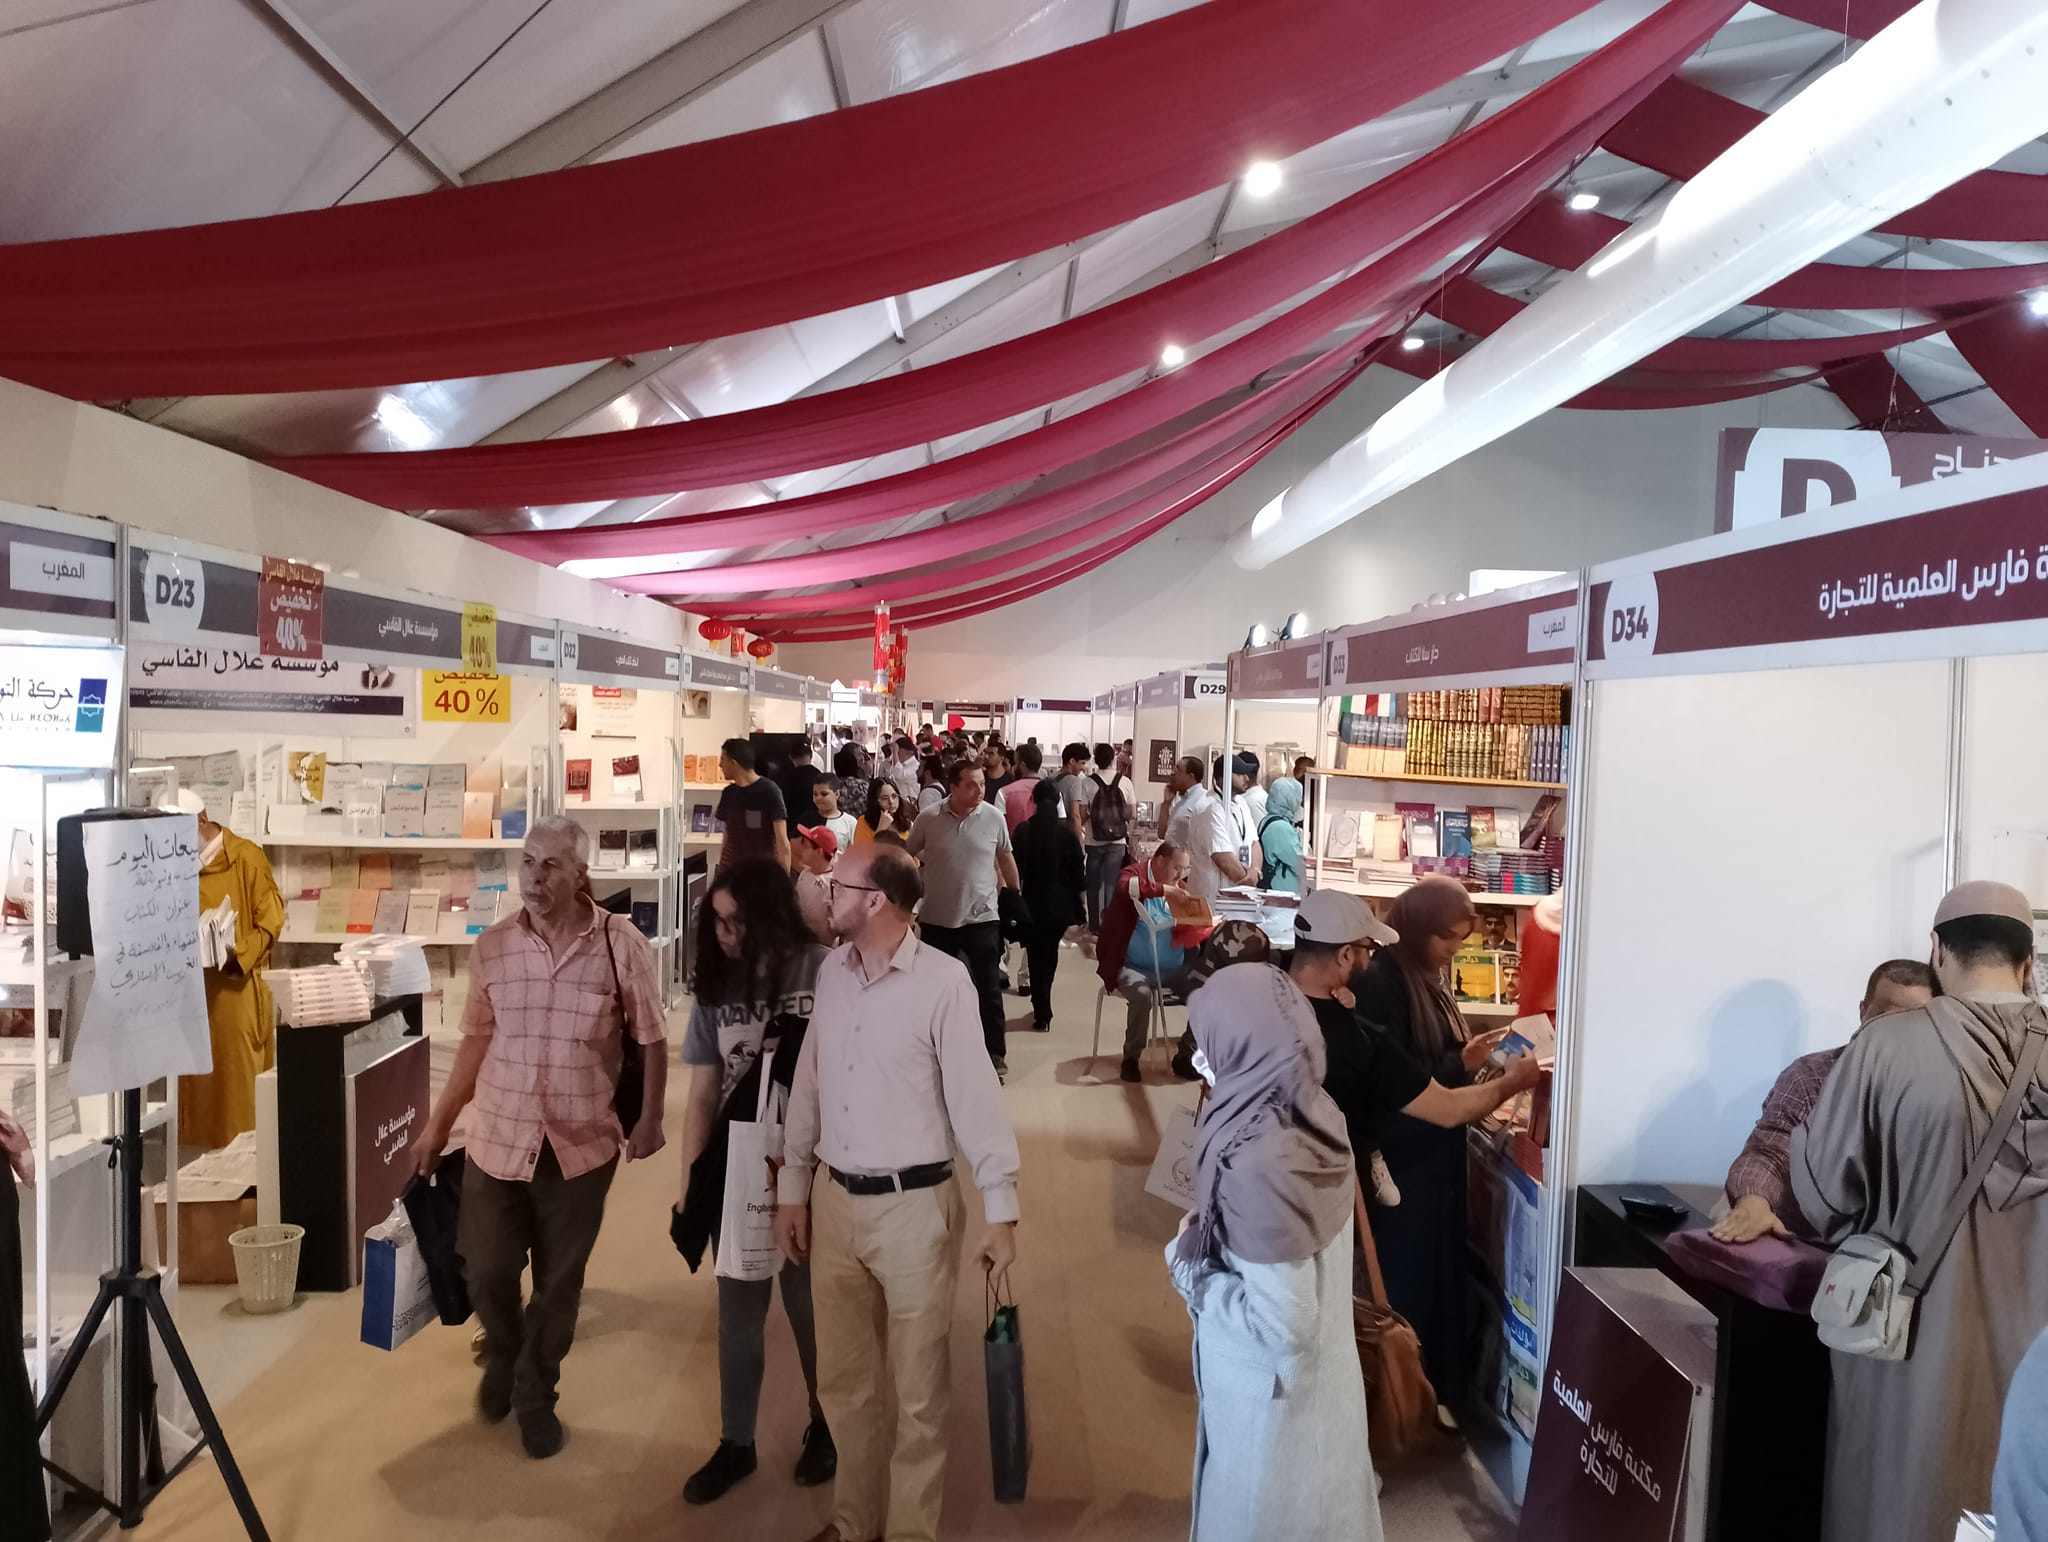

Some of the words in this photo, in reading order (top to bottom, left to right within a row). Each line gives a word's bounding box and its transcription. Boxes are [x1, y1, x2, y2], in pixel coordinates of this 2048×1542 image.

[42, 562, 85, 579] المغرب
[1881, 559, 1957, 609] العلمية
[1962, 549, 2029, 600] فارس
[156, 574, 195, 608] D23
[270, 584, 312, 612] تخفيض
[1819, 573, 1877, 619] للتجارة
[276, 615, 307, 652] 40%
[378, 616, 402, 637] الفاسي
[414, 620, 439, 641] مؤسسة
[1543, 616, 1566, 639] المغرب
[1611, 606, 1649, 643] D34
[142, 647, 208, 677] الفاسي
[214, 649, 264, 674] علال
[469, 636, 491, 668] 40%
[564, 642, 576, 658] D22
[1333, 655, 1345, 674] D33
[28, 678, 73, 710] حركة
[434, 690, 470, 713] 40
[1200, 683, 1226, 695] D29
[106, 833, 155, 873] اليوم
[389, 1104, 416, 1134] مؤسسة
[384, 1129, 408, 1165] الفاسي
[1553, 1369, 1593, 1426] العلمية
[1591, 1421, 1624, 1462] فارس
[1580, 1439, 1618, 1497] للتجارة
[1625, 1446, 1662, 1504] مكتبة
